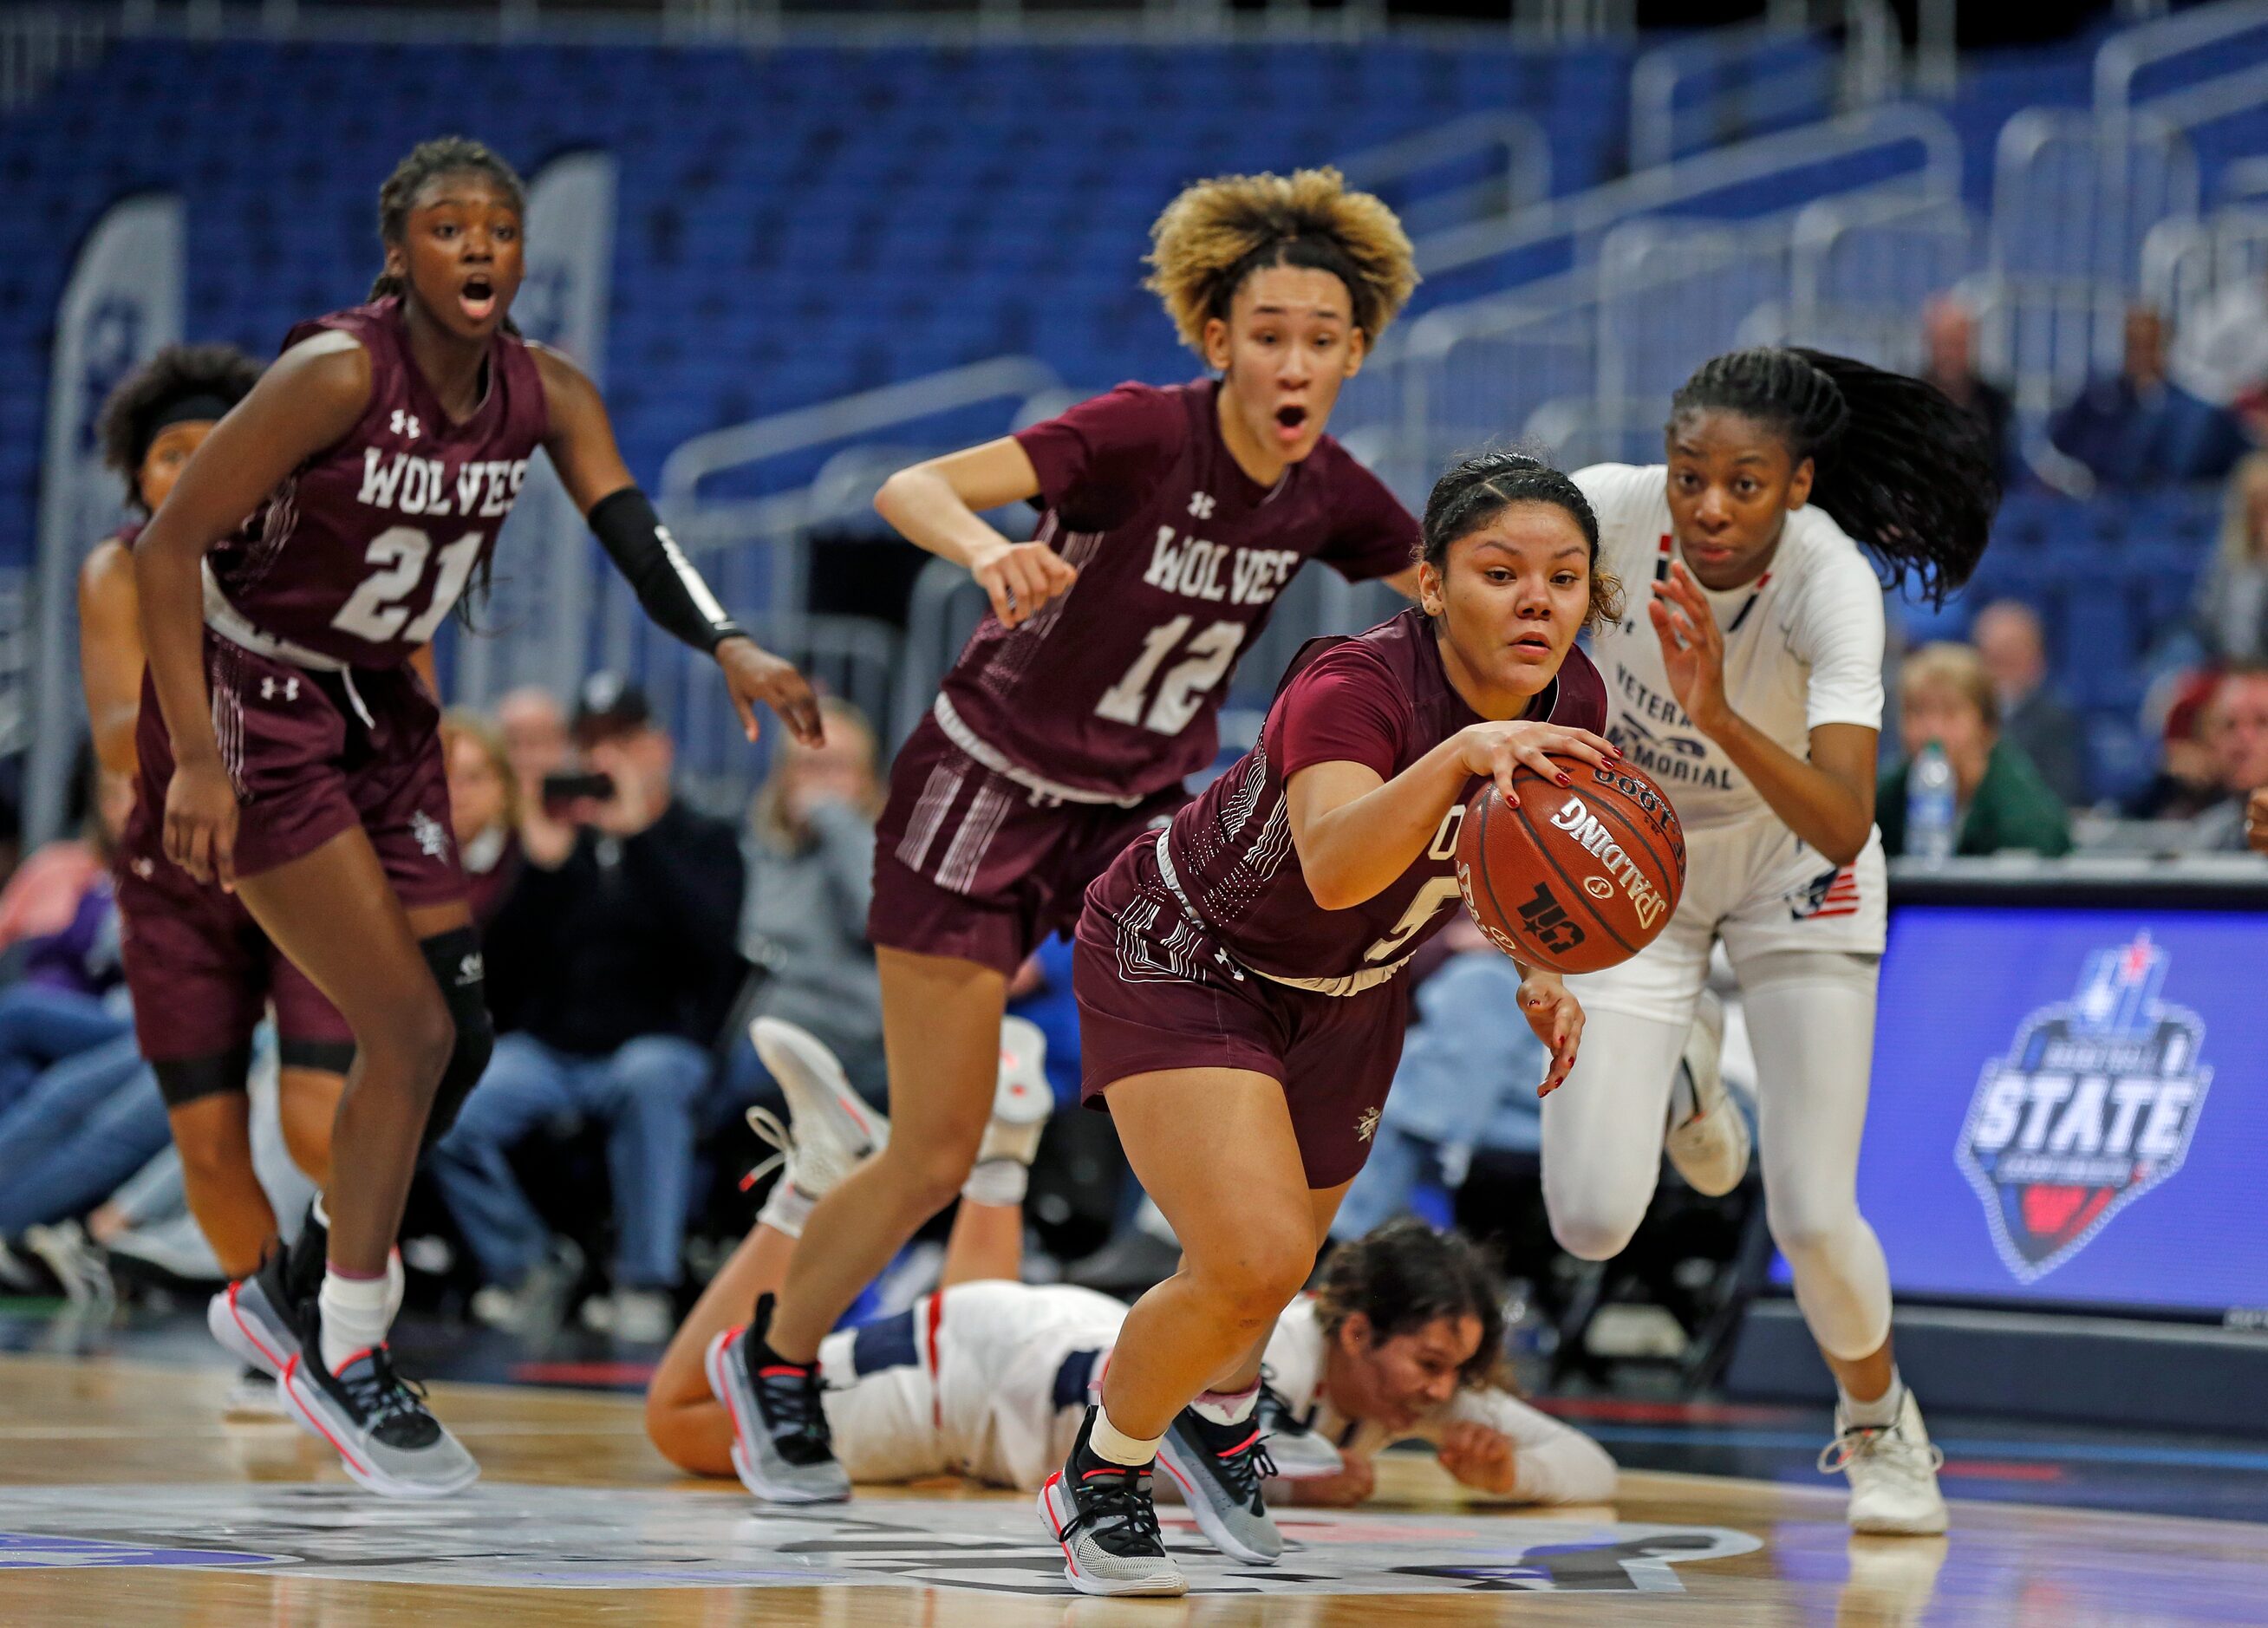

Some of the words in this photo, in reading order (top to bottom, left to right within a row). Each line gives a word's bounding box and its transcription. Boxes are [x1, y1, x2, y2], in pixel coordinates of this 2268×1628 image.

[356, 446, 528, 518] WOLVES
[330, 526, 485, 643] 21
[1094, 614, 1247, 736] 12
[1617, 661, 1693, 730] VETERA
[1606, 724, 1734, 791] MMORIAL
[1550, 794, 1667, 929] SPALDING
[1972, 1073, 2197, 1155] STATE
